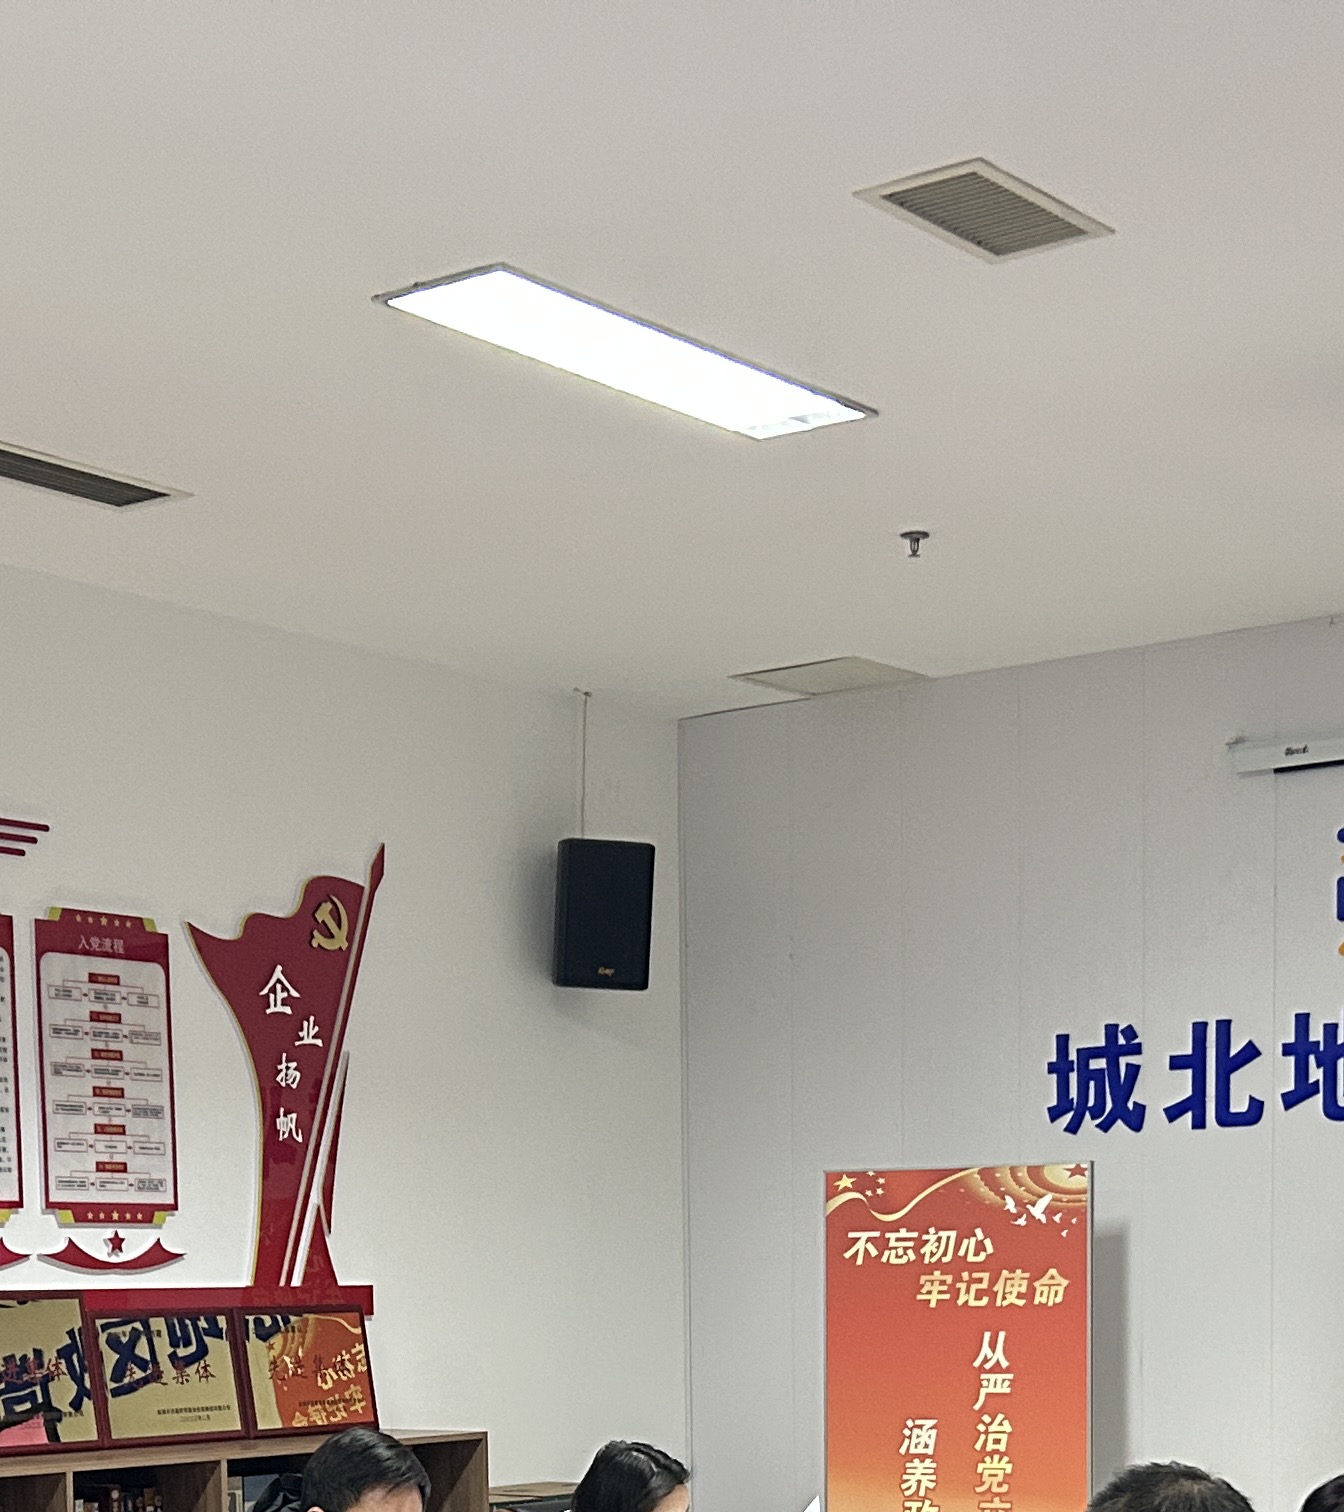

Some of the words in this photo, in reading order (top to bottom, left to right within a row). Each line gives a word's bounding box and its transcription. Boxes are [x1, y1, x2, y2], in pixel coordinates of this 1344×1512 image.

[77, 935, 125, 955] 入党流程
[258, 964, 324, 1144] 企业扬帆
[843, 1226, 995, 1267] 不忘初心
[915, 1267, 1071, 1310] 牢记使命
